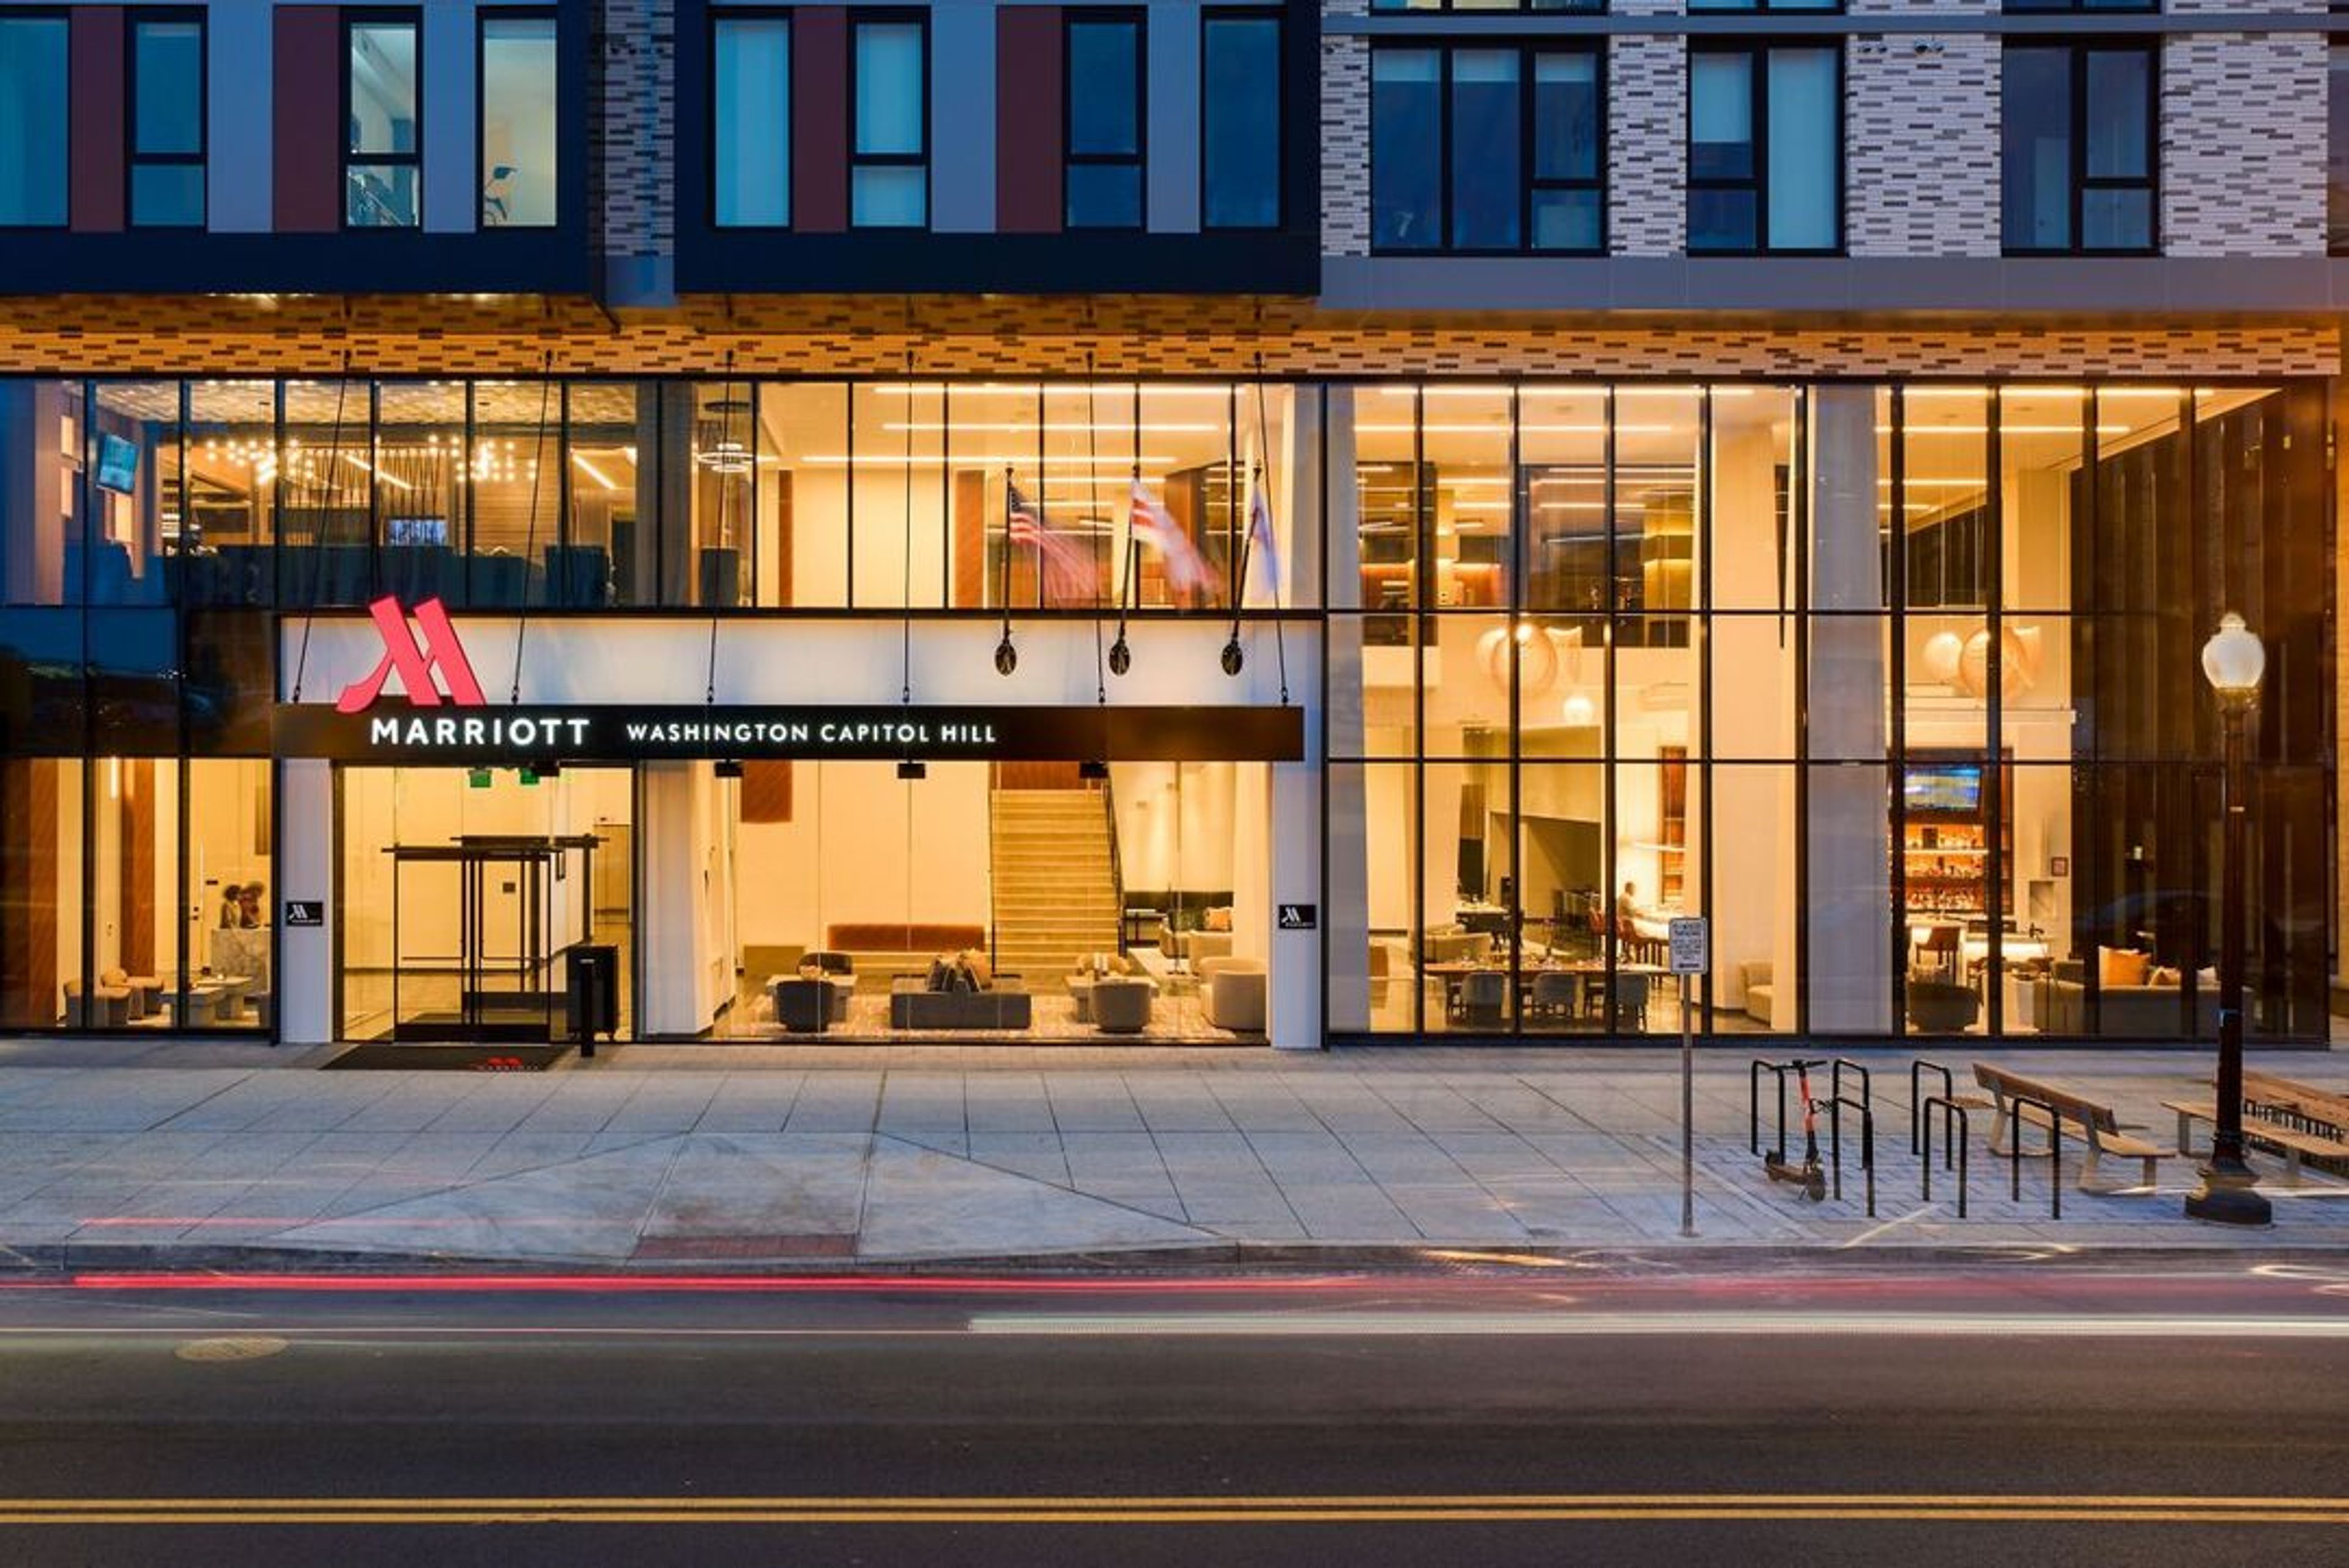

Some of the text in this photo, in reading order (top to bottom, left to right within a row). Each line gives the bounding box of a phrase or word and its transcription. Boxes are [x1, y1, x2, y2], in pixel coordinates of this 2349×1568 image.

[370, 717, 590, 746] MARRIOTT
[626, 723, 996, 743] WASHINGTON CAPITOL HILL
